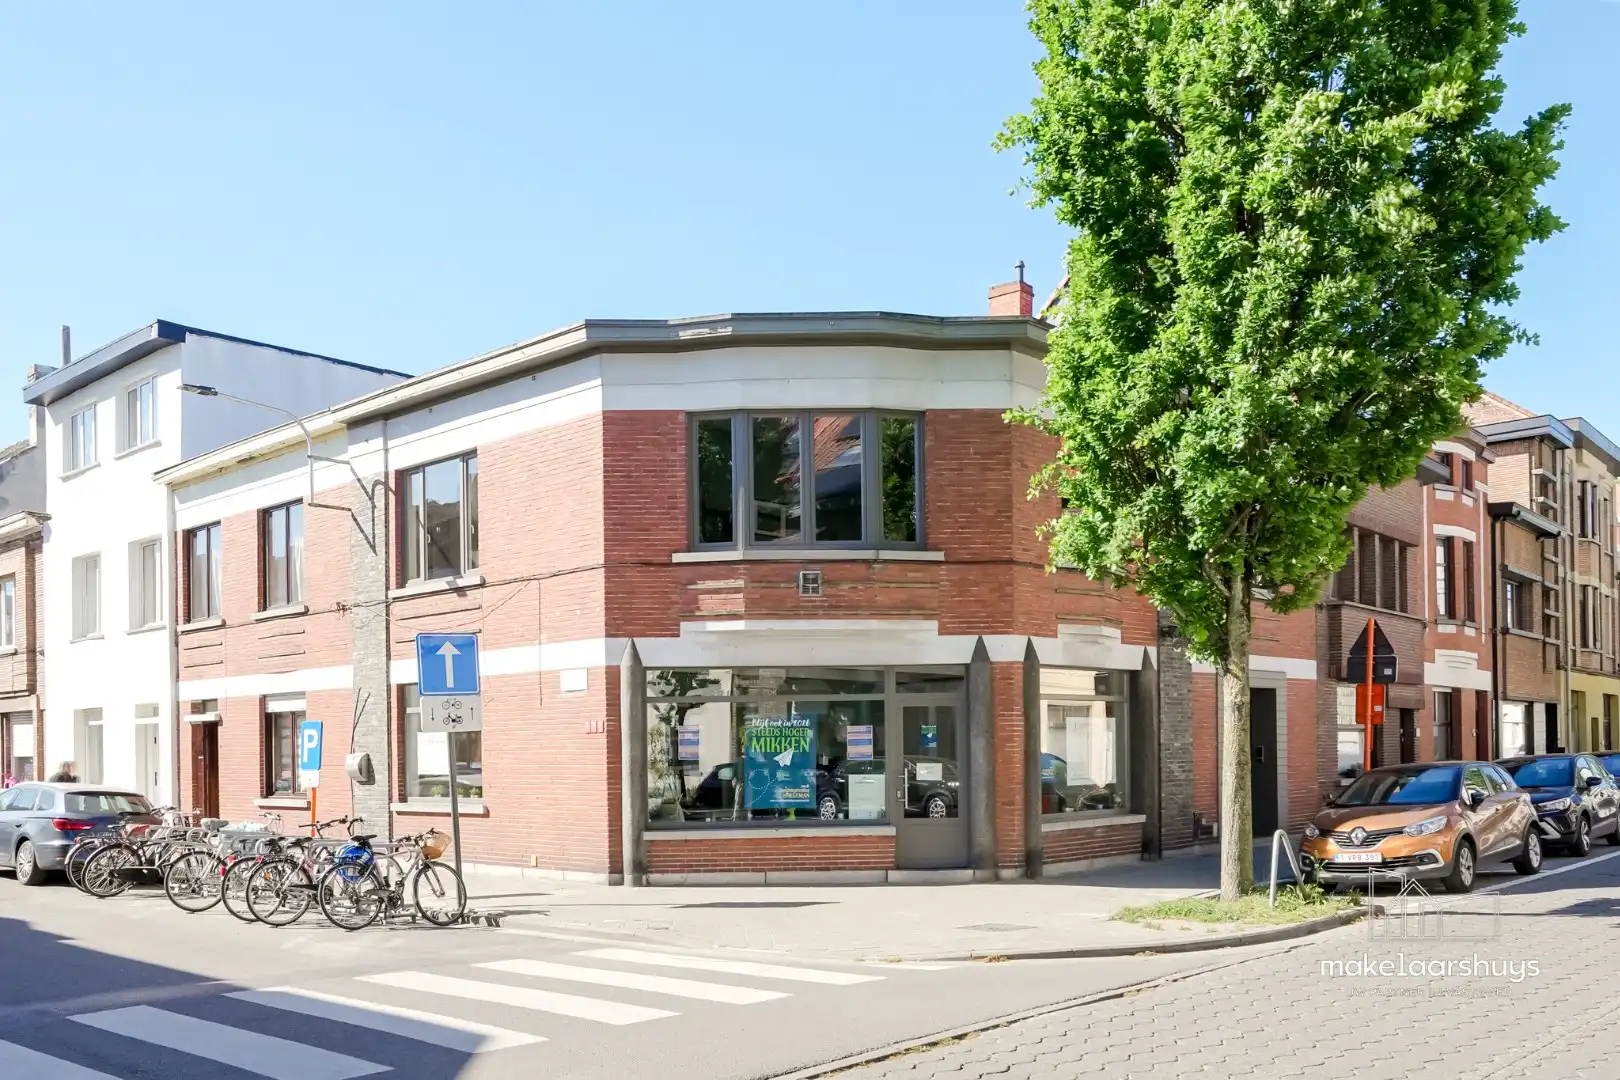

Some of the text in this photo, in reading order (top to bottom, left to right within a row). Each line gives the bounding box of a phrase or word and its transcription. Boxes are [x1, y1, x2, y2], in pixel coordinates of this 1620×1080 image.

[752, 728, 781, 736] STEEDS
[303, 728, 319, 763] P
[752, 737, 810, 752] MIKKEN
